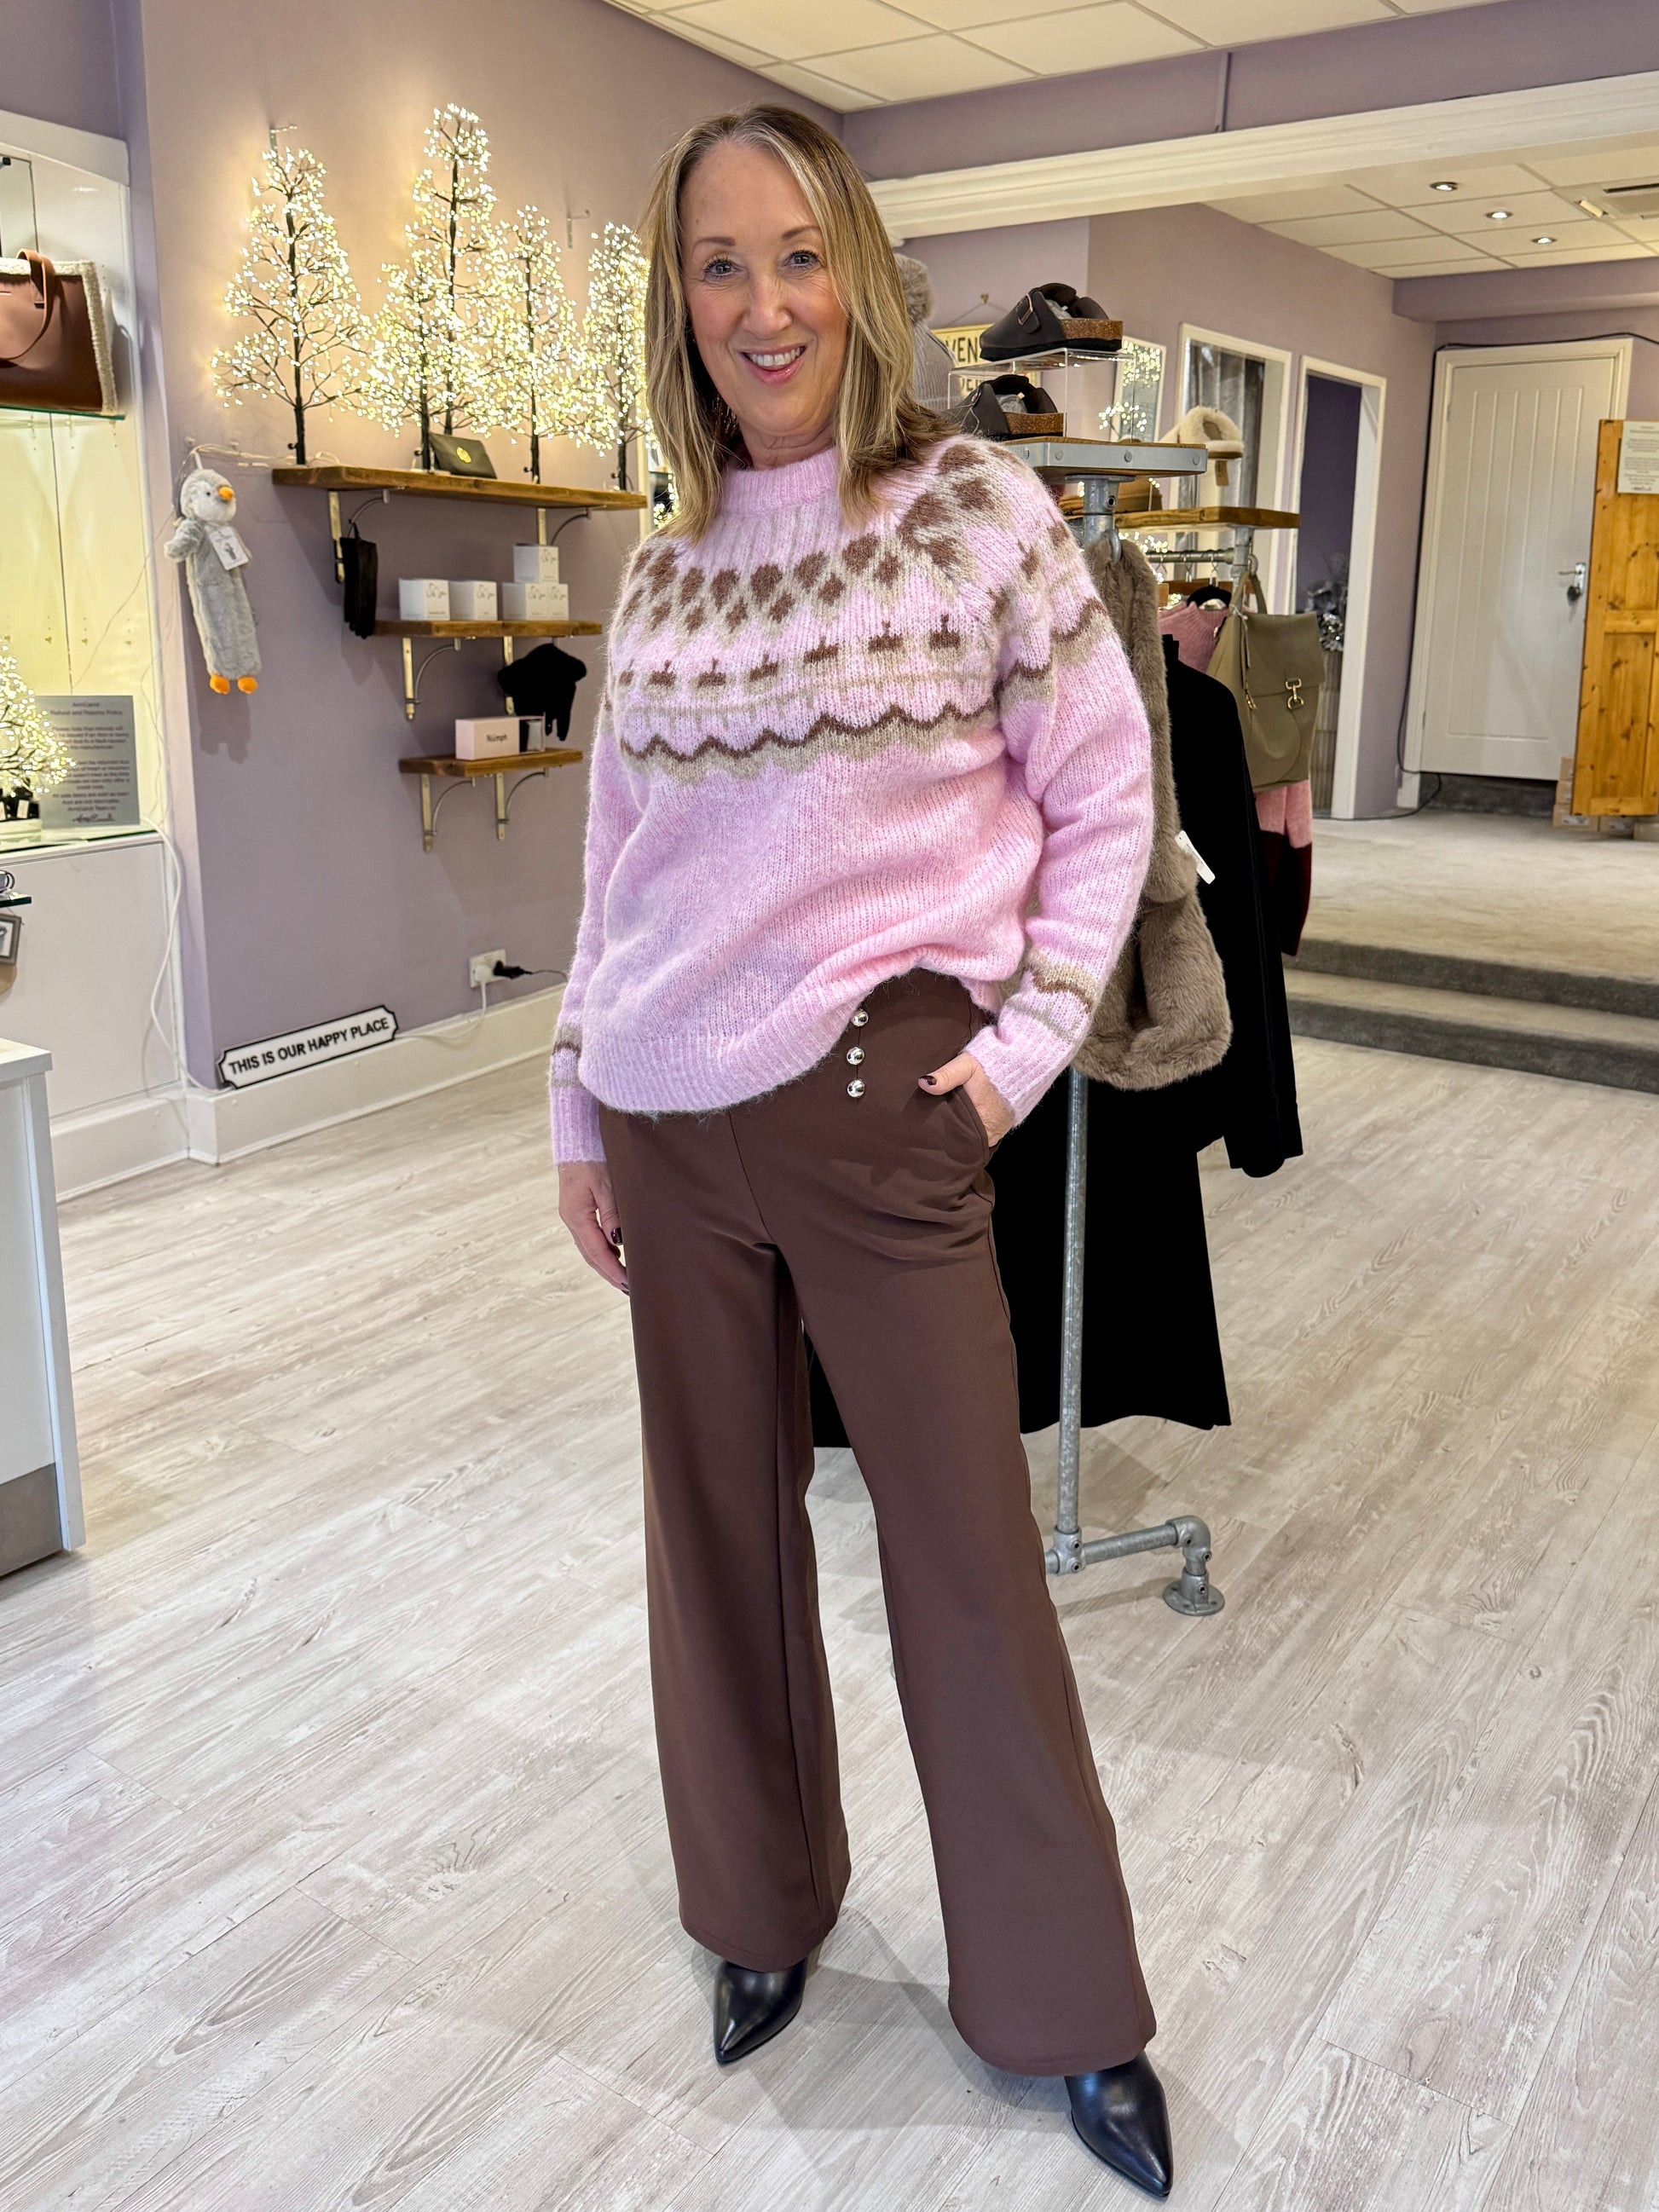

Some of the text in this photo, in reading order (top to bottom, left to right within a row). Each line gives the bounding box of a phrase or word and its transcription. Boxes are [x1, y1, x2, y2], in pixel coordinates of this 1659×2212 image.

[228, 1017, 390, 1075] THIS IS OUR HAPPY PLACE
